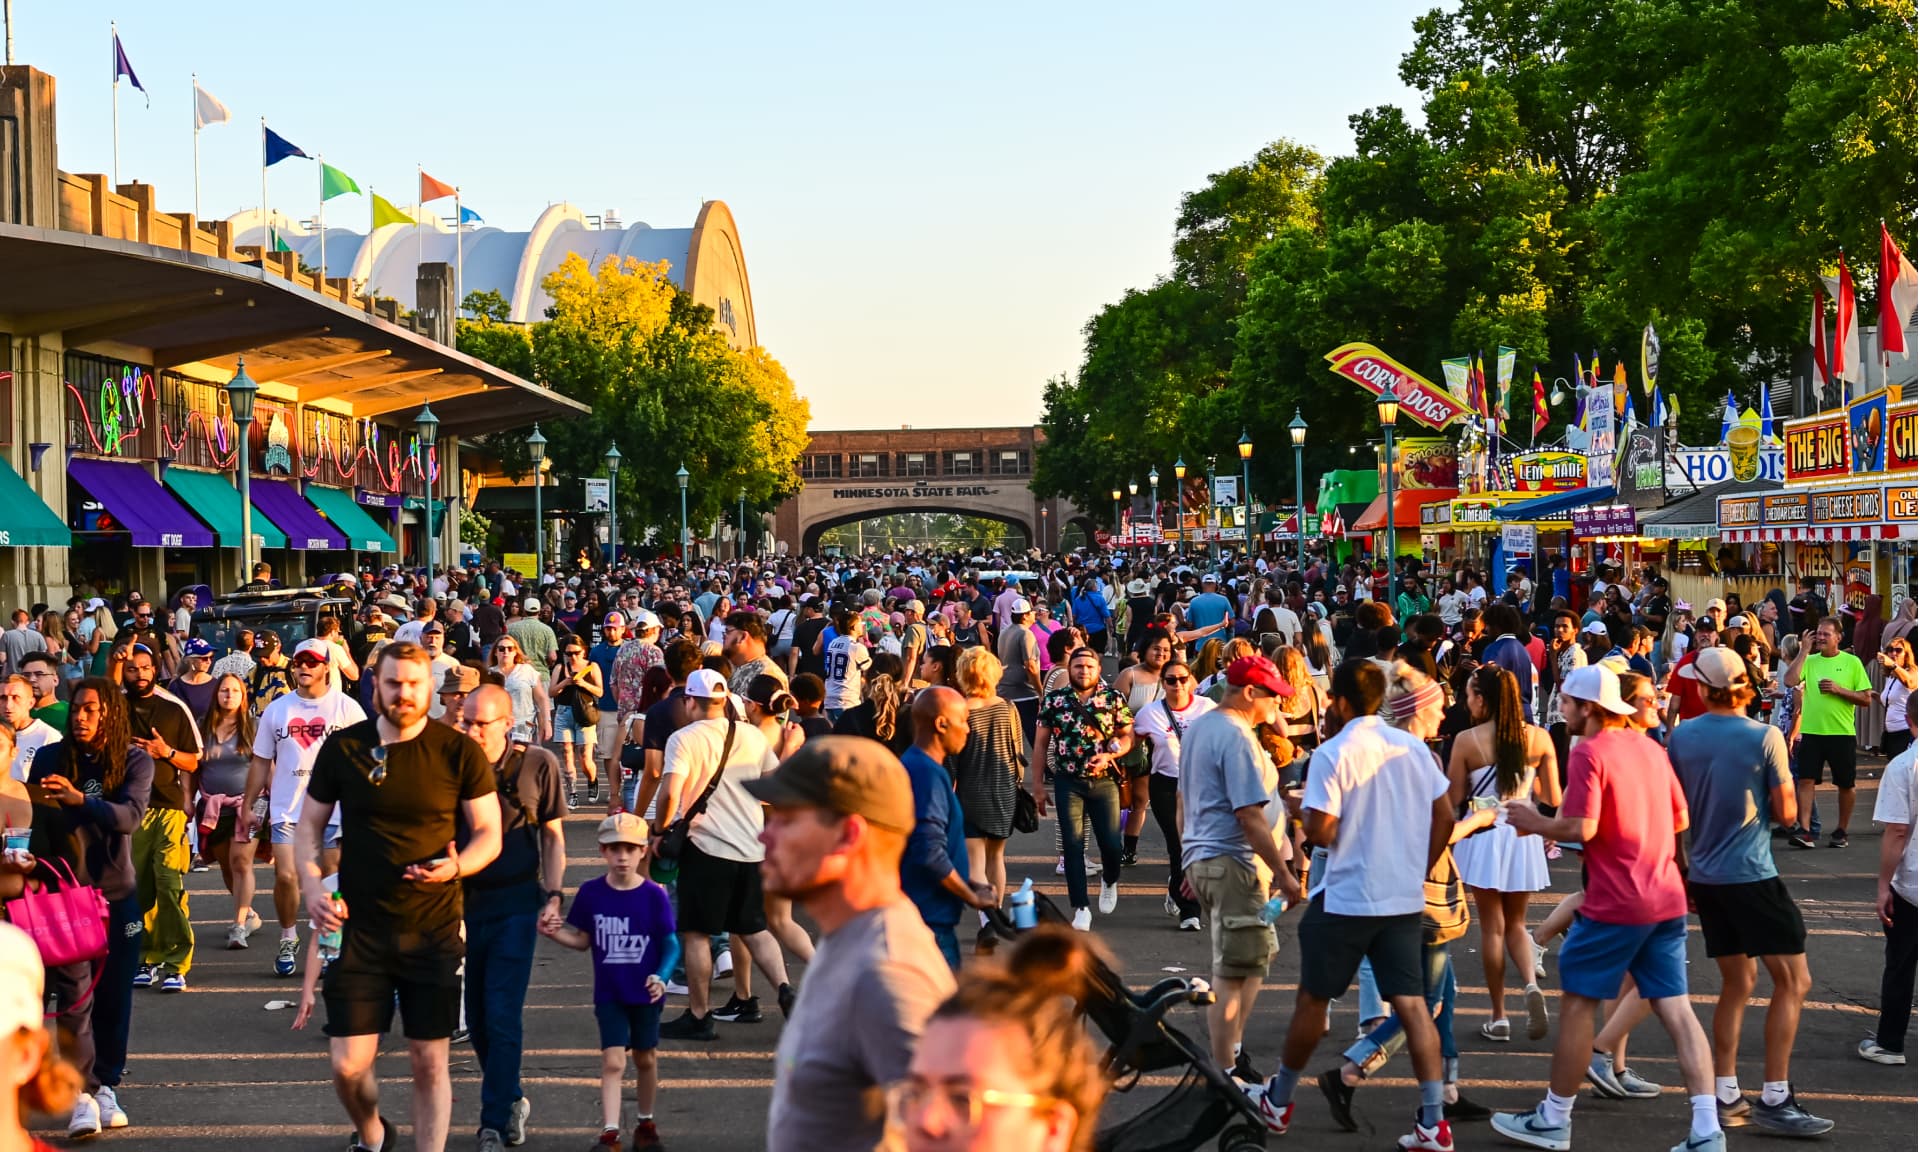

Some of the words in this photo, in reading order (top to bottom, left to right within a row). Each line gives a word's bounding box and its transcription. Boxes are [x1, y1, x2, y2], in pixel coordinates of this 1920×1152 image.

[1353, 359, 1400, 390] CORN
[1403, 388, 1452, 421] DOGS
[1789, 431, 1816, 473] THE
[1818, 425, 1843, 469] BIG
[1893, 414, 1918, 461] CH
[1686, 453, 1730, 481] HO
[833, 488, 910, 499] MINNESOTA
[913, 487, 953, 497] STATE
[957, 486, 990, 496] FAIR
[1829, 495, 1854, 518] CHEESE
[1855, 493, 1879, 517] CURDS
[1461, 509, 1491, 522] LIMEADE
[1765, 506, 1787, 521] CHEDDAR
[1788, 505, 1808, 520] CHEESE
[1662, 527, 1672, 537] We
[1674, 527, 1689, 537] have
[1690, 526, 1705, 537] DIET
[275, 724, 343, 742] SUPREM
[593, 913, 630, 951] THIN
[602, 934, 651, 964] LIZZY
